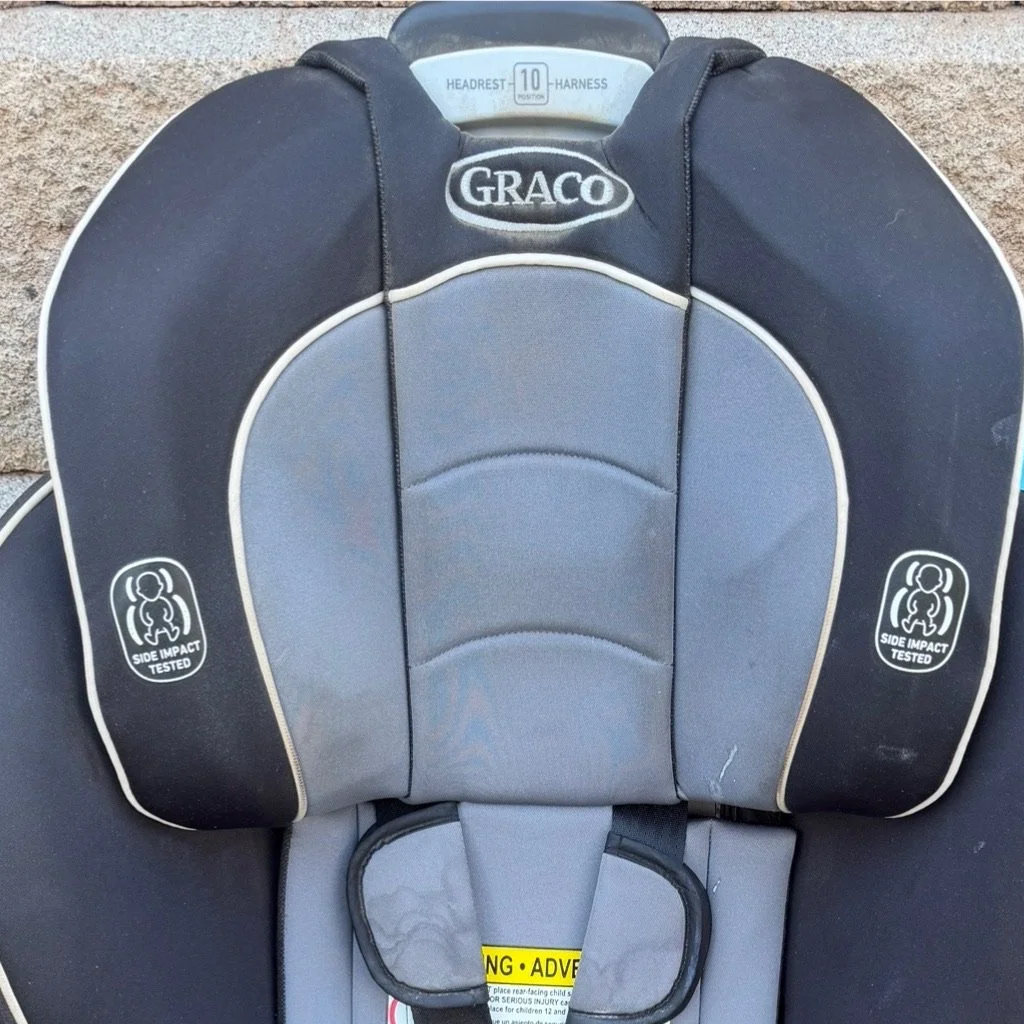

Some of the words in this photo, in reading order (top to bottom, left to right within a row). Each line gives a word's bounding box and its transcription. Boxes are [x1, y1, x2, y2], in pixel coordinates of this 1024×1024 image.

[446, 78, 506, 91] HEADREST
[520, 68, 540, 92] 10
[554, 78, 608, 91] HARNESS
[459, 166, 615, 207] GRACO
[880, 632, 905, 649] SIDE
[907, 637, 949, 654] IMPACT
[132, 650, 159, 665] SIDE
[160, 640, 201, 660] IMPACT
[891, 648, 933, 665] TESTED
[148, 657, 191, 675] TESTED
[493, 986, 511, 995] place
[513, 987, 548, 997] rear-facing
[502, 996, 533, 1005] SERIOUS
[534, 998, 559, 1006] INJURY
[516, 1006, 542, 1014] children
